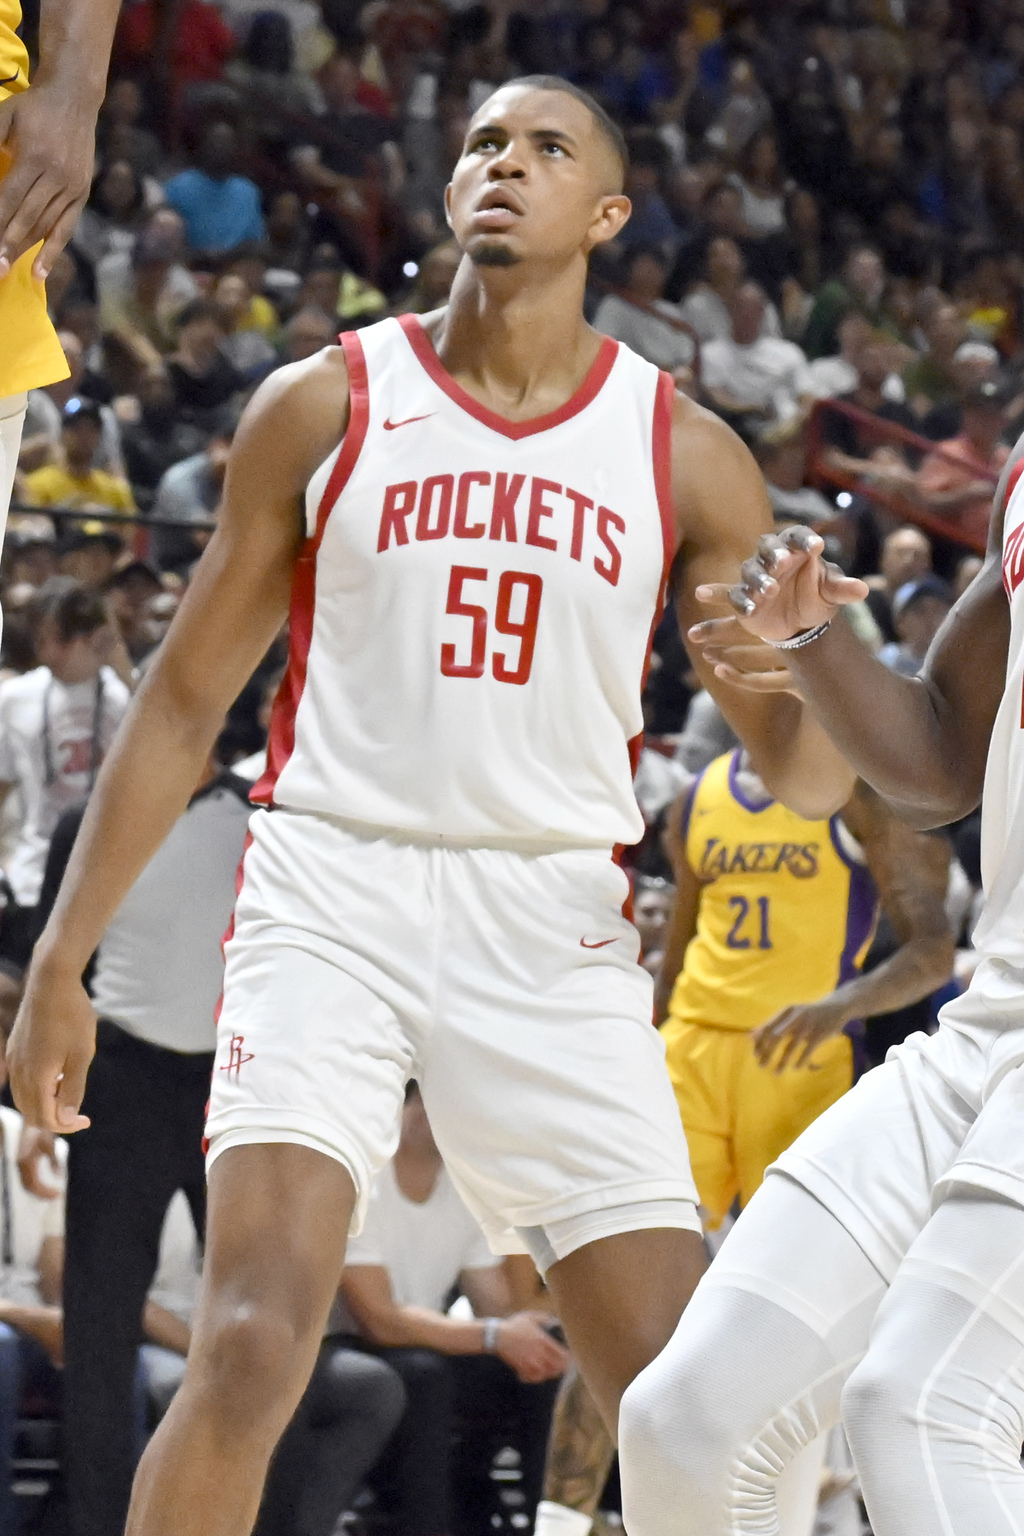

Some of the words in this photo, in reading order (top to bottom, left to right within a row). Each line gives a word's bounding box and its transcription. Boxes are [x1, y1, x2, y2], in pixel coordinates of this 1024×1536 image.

[377, 470, 625, 587] ROCKETS
[440, 565, 543, 686] 59
[697, 838, 820, 883] LAKERS
[726, 895, 773, 949] 21
